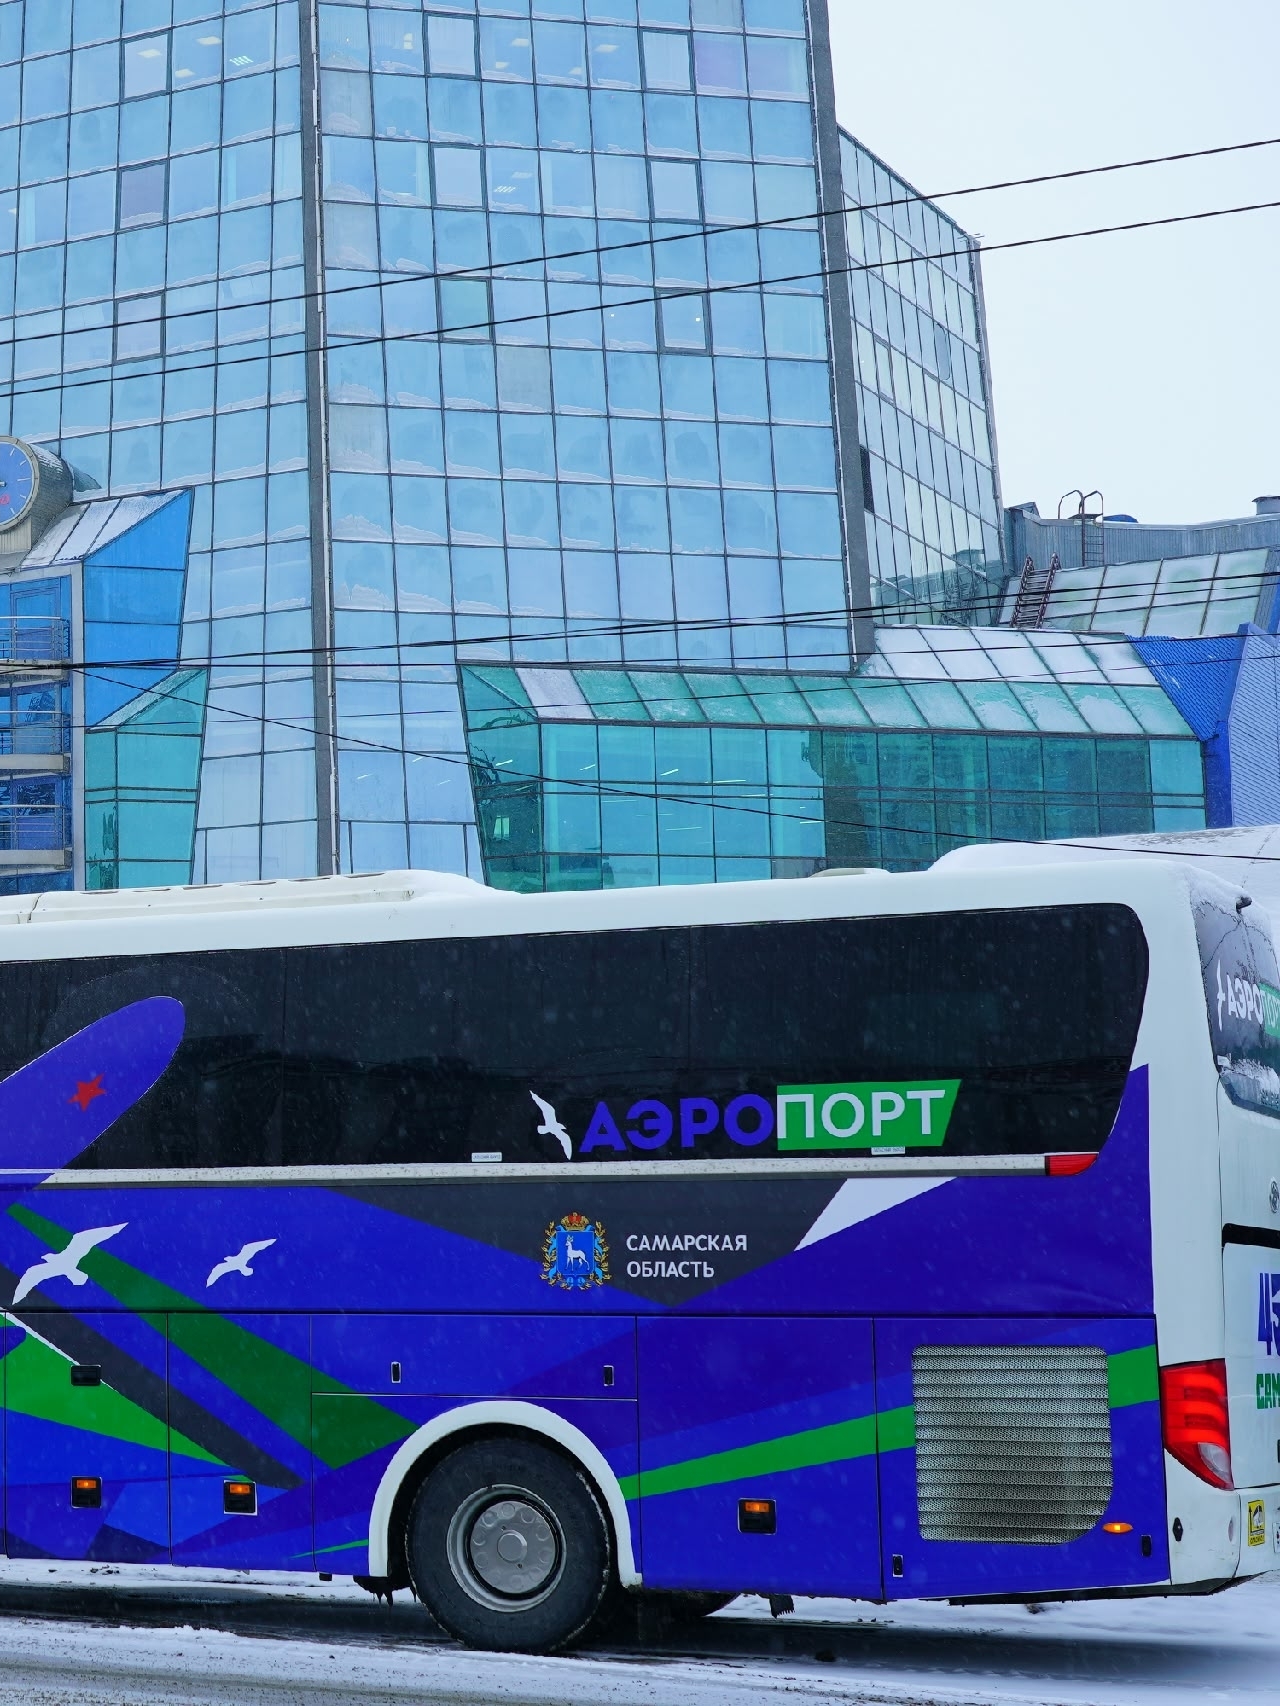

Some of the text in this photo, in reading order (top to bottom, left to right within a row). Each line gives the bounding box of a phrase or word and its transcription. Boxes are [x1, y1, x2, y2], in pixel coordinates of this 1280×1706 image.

[578, 1089, 946, 1153] АЭРОПОРТ
[625, 1234, 748, 1253] САМАРСКАЯ
[625, 1260, 715, 1279] ОБЛАСТЬ
